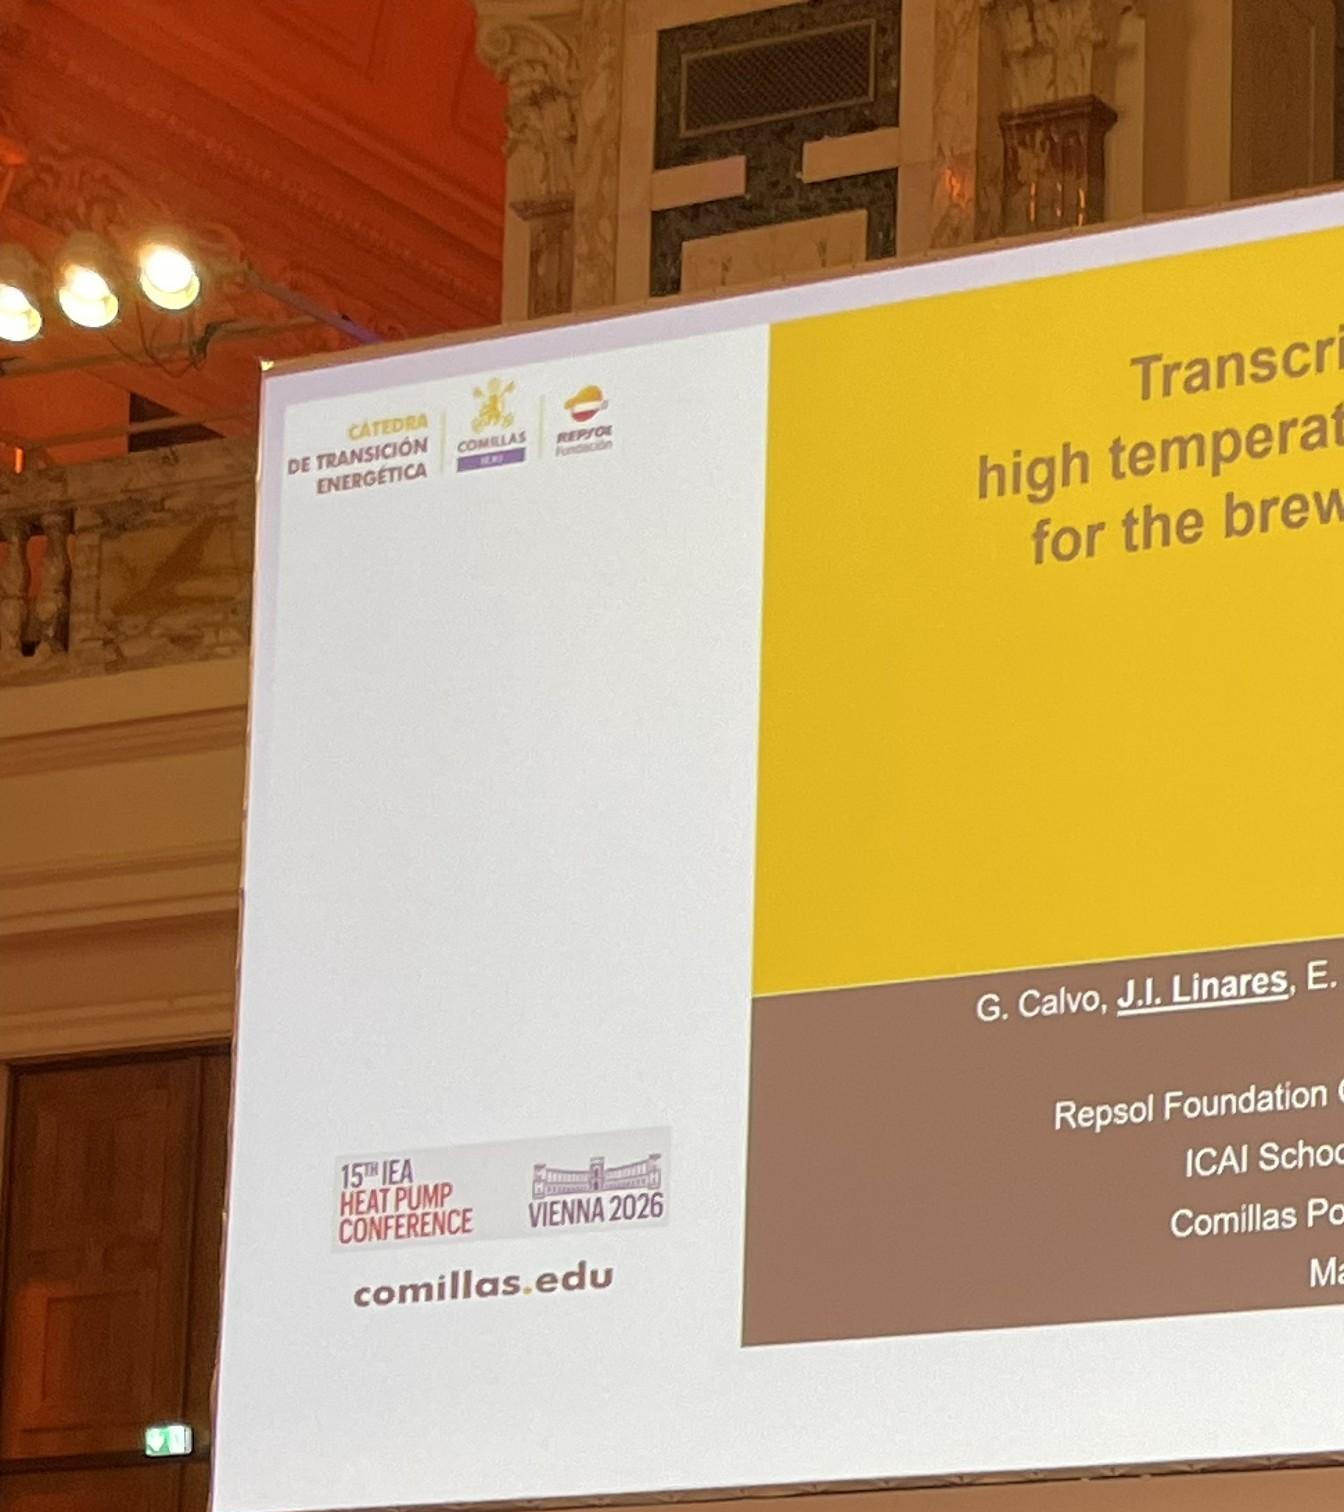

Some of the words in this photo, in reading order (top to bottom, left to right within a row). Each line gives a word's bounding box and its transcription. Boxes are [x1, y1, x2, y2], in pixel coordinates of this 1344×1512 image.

[348, 412, 428, 441] CÁTEDRA
[457, 430, 527, 453] COMILLAS
[287, 455, 312, 476] DE
[316, 436, 429, 472] TRANSICIÓN
[978, 441, 1090, 504] high
[316, 462, 428, 495] ENERGÉTICA
[1031, 517, 1106, 565] for
[1121, 504, 1205, 552] the
[976, 993, 1008, 1022] G.
[1018, 985, 1107, 1017] Calvo,
[1117, 976, 1161, 1010] J.I.
[1172, 968, 1296, 1004] Linares,
[1307, 960, 1337, 990] E.
[1055, 1094, 1154, 1132] Repsol
[1164, 1081, 1327, 1120] Foundation
[341, 1160, 378, 1190] 15TH
[382, 1158, 413, 1186] IEA
[1185, 1145, 1248, 1177] ICAI
[340, 1188, 393, 1217] HEAT
[395, 1182, 452, 1212] PUMP
[528, 1198, 604, 1228] VIENNA
[608, 1192, 664, 1222] 2026
[339, 1208, 474, 1244] CONFERENCE
[1170, 1203, 1297, 1238] Comillas
[354, 1260, 614, 1307] comillas.edu
